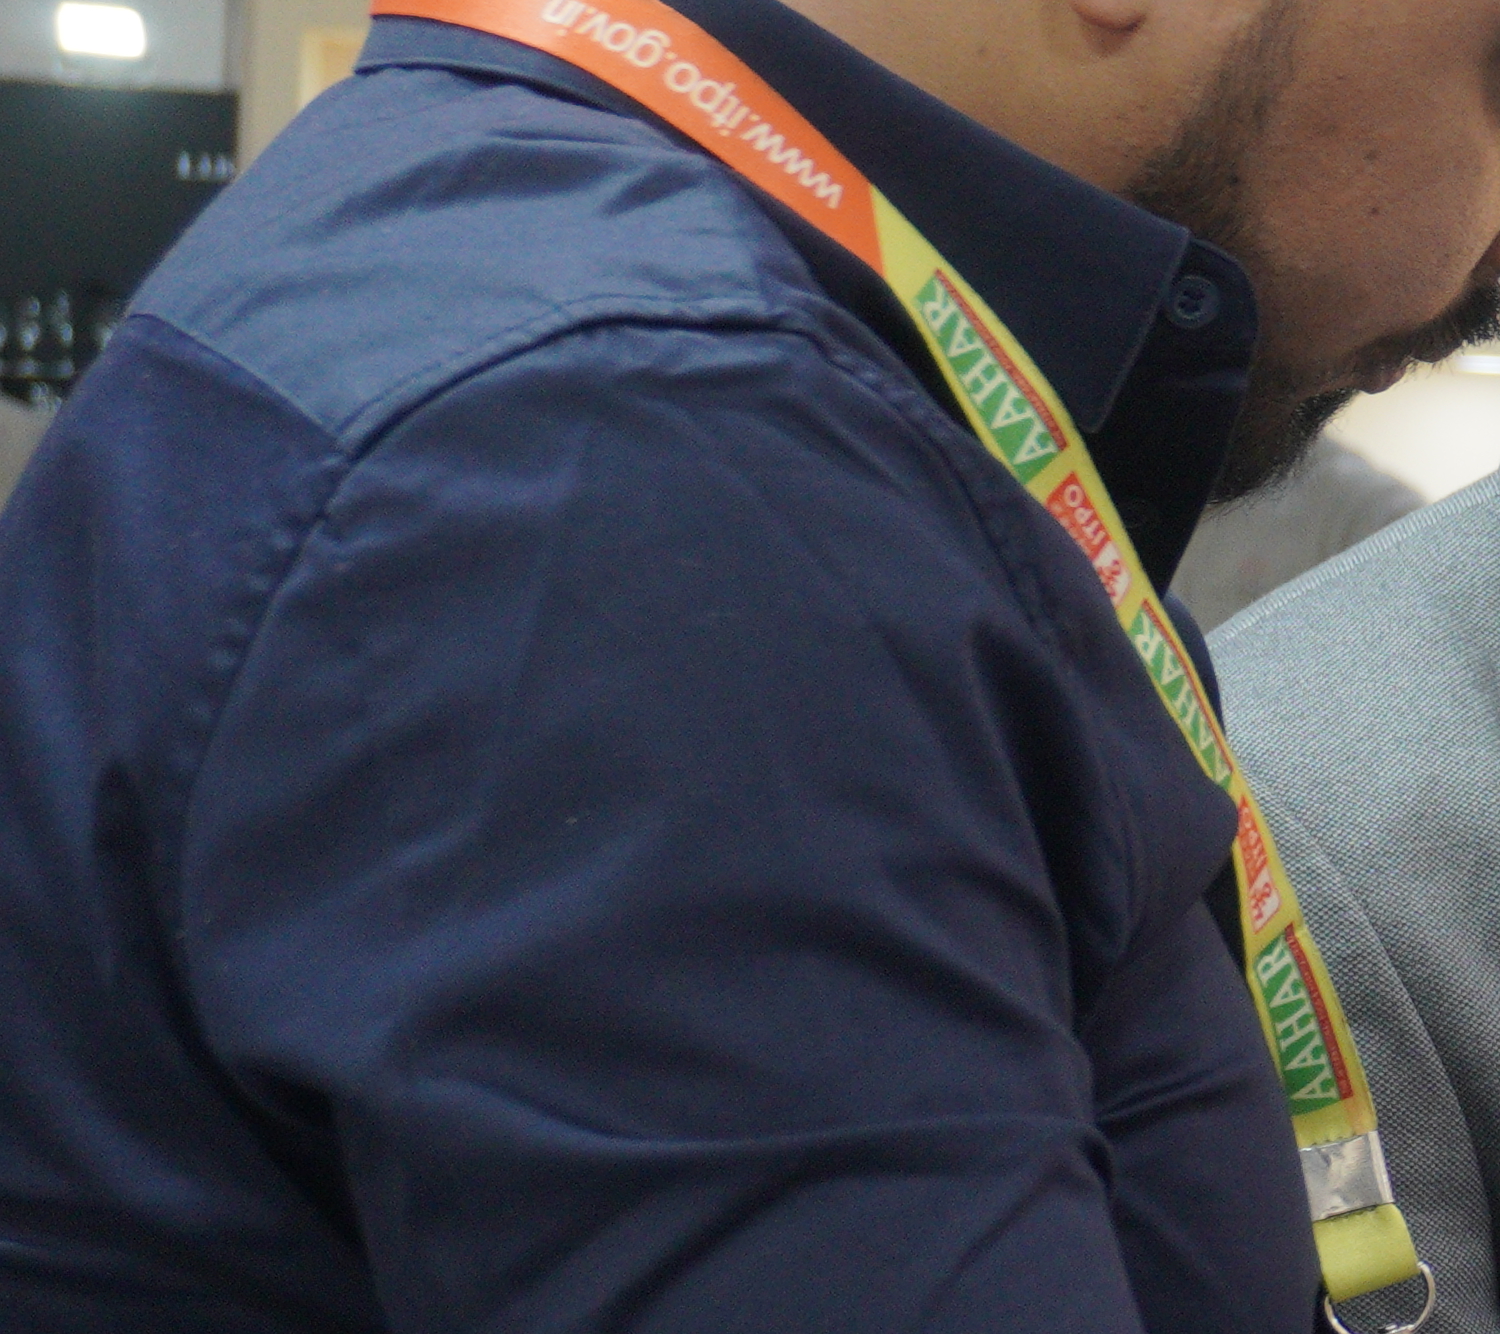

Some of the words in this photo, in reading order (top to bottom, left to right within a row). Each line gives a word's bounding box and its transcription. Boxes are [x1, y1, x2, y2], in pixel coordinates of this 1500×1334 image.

[922, 276, 1060, 465] AAHAR
[1062, 482, 1107, 545] ITPO
[1134, 608, 1232, 783] AAHAR
[1257, 935, 1342, 1101] AAHAR
